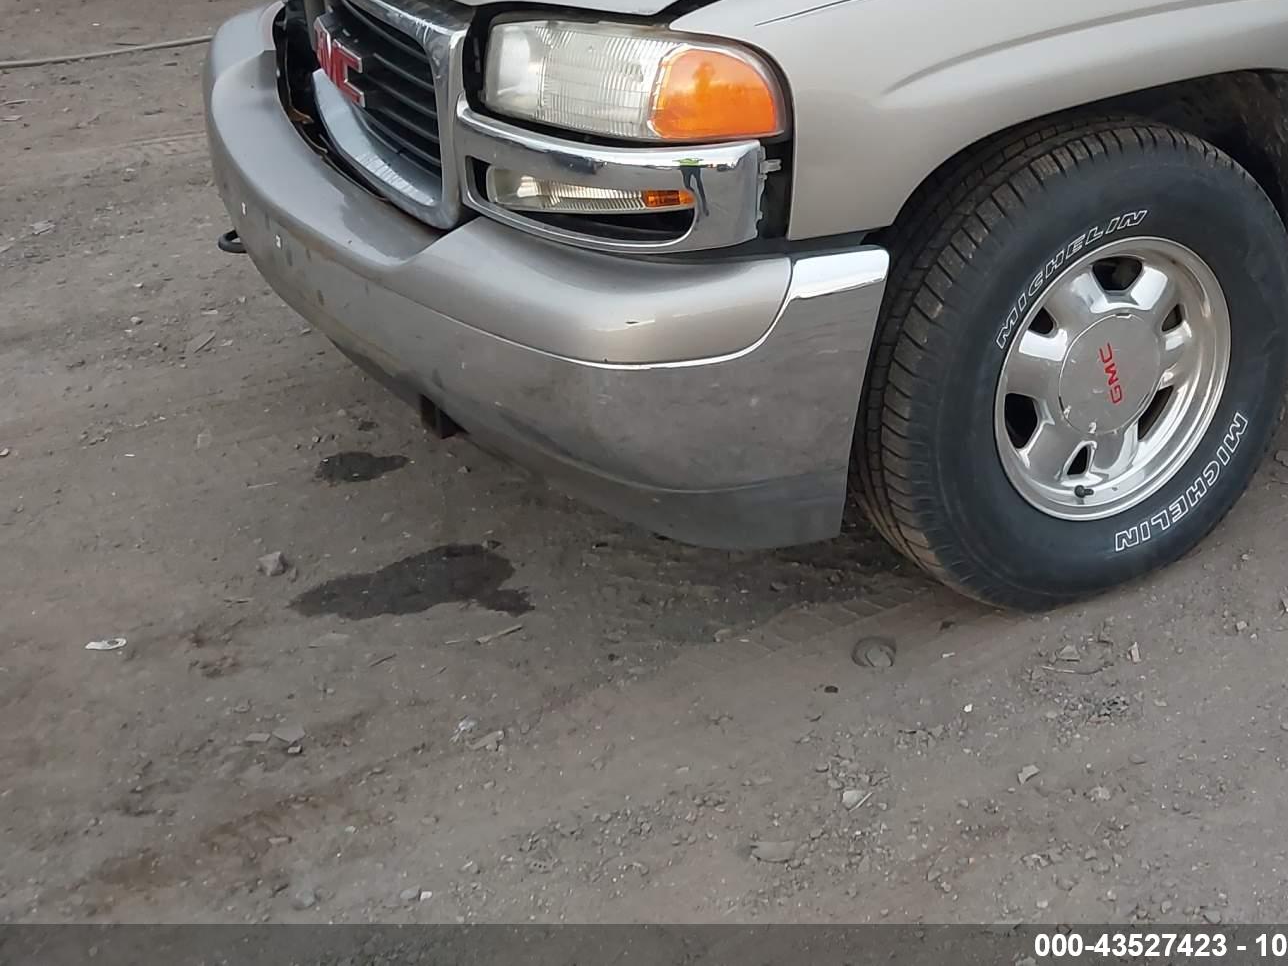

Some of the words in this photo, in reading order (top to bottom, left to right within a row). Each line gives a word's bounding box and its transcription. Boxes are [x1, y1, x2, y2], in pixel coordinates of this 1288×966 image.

[313, 17, 365, 108] MC
[996, 209, 1148, 350] MICHELIN
[1099, 342, 1123, 405] GMC
[1115, 412, 1249, 552] MICHELIN
